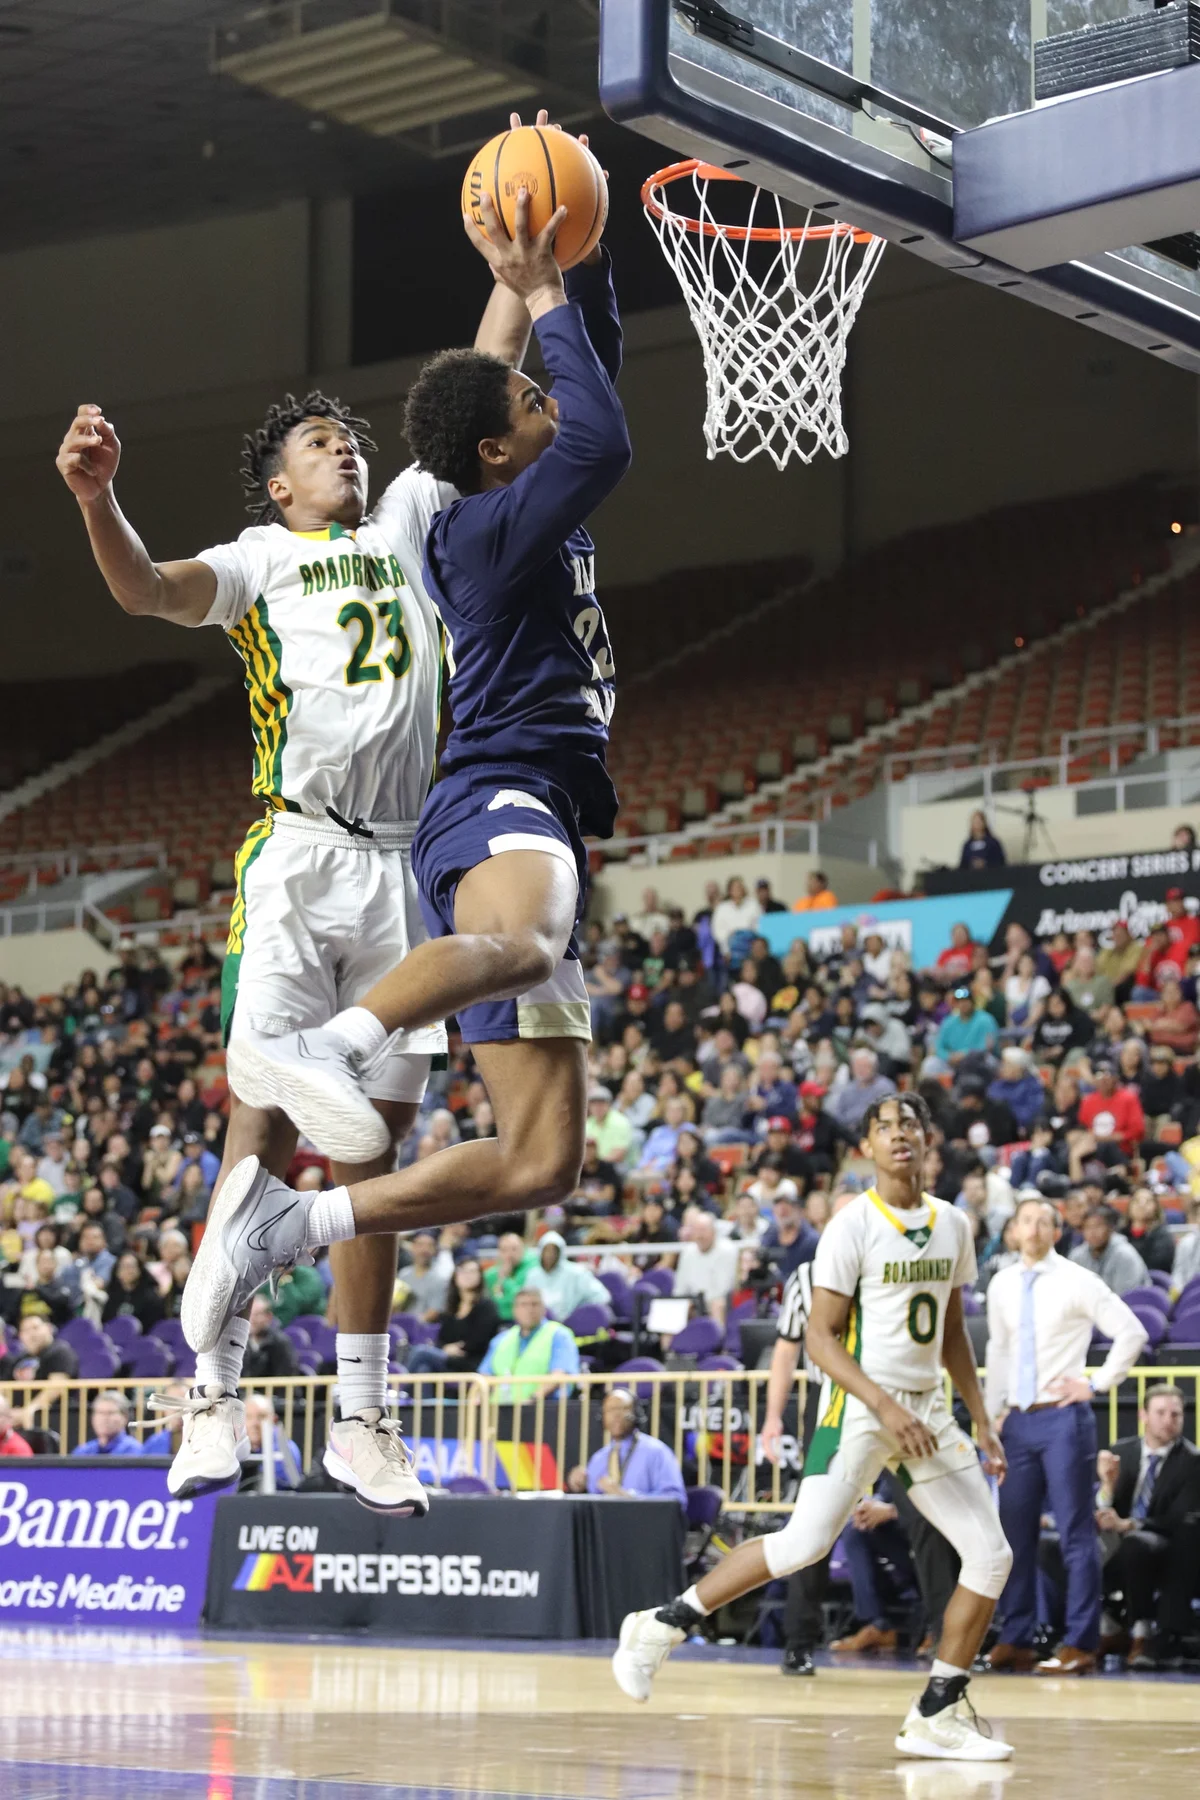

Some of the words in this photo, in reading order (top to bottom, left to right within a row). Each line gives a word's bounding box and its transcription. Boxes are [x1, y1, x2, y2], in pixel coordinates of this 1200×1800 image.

[335, 598, 413, 687] 23
[1039, 857, 1129, 887] CONCERT
[1130, 851, 1189, 878] SERIES
[907, 1290, 938, 1345] 0
[238, 1525, 285, 1551] LIVE
[286, 1526, 319, 1551] ON
[0, 1574, 58, 1608] orts
[57, 1573, 186, 1612] Medicine
[263, 1553, 539, 1597] AZPREPS365.COM
